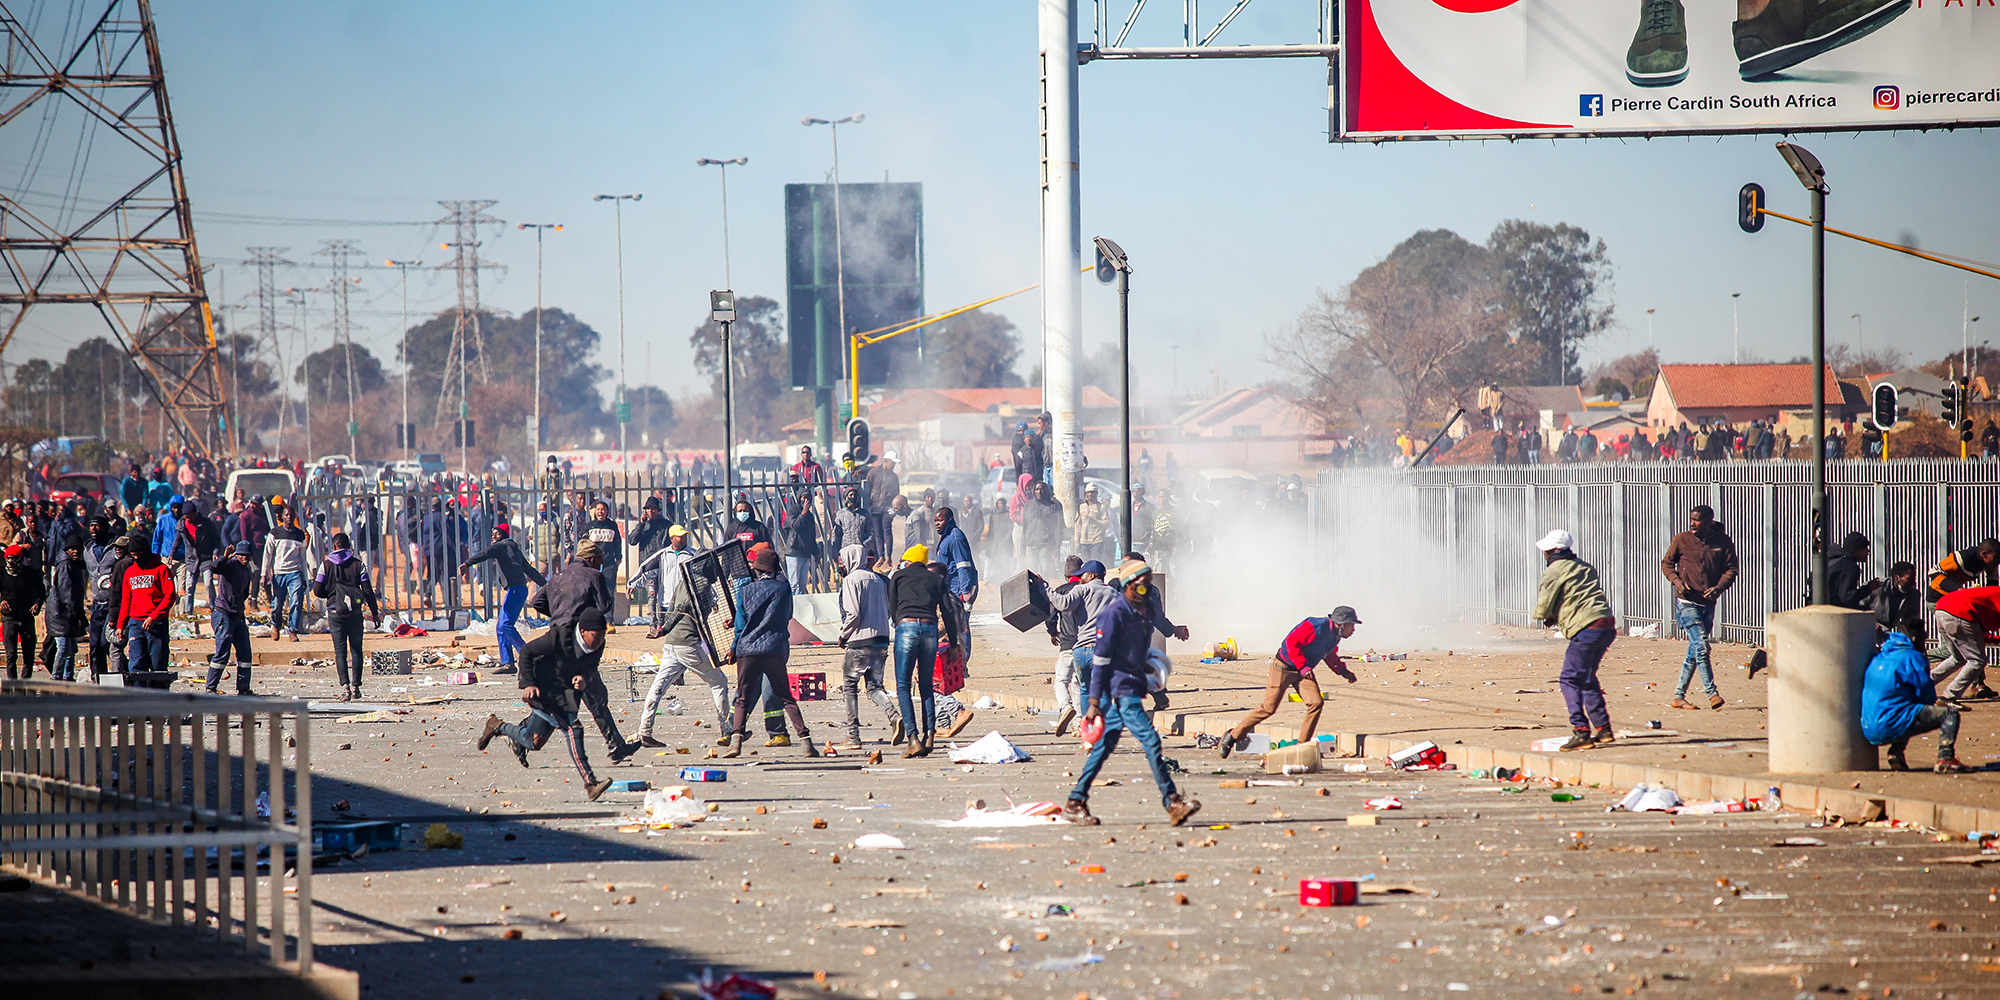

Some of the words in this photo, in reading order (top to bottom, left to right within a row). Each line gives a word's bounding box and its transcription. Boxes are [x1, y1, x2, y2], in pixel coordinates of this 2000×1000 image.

[1611, 98, 1662, 112] Pierre
[1667, 96, 1724, 110] Cardin
[1729, 94, 1780, 109] South
[1784, 94, 1837, 108] Africa
[1906, 88, 2000, 108] pierrecardi
